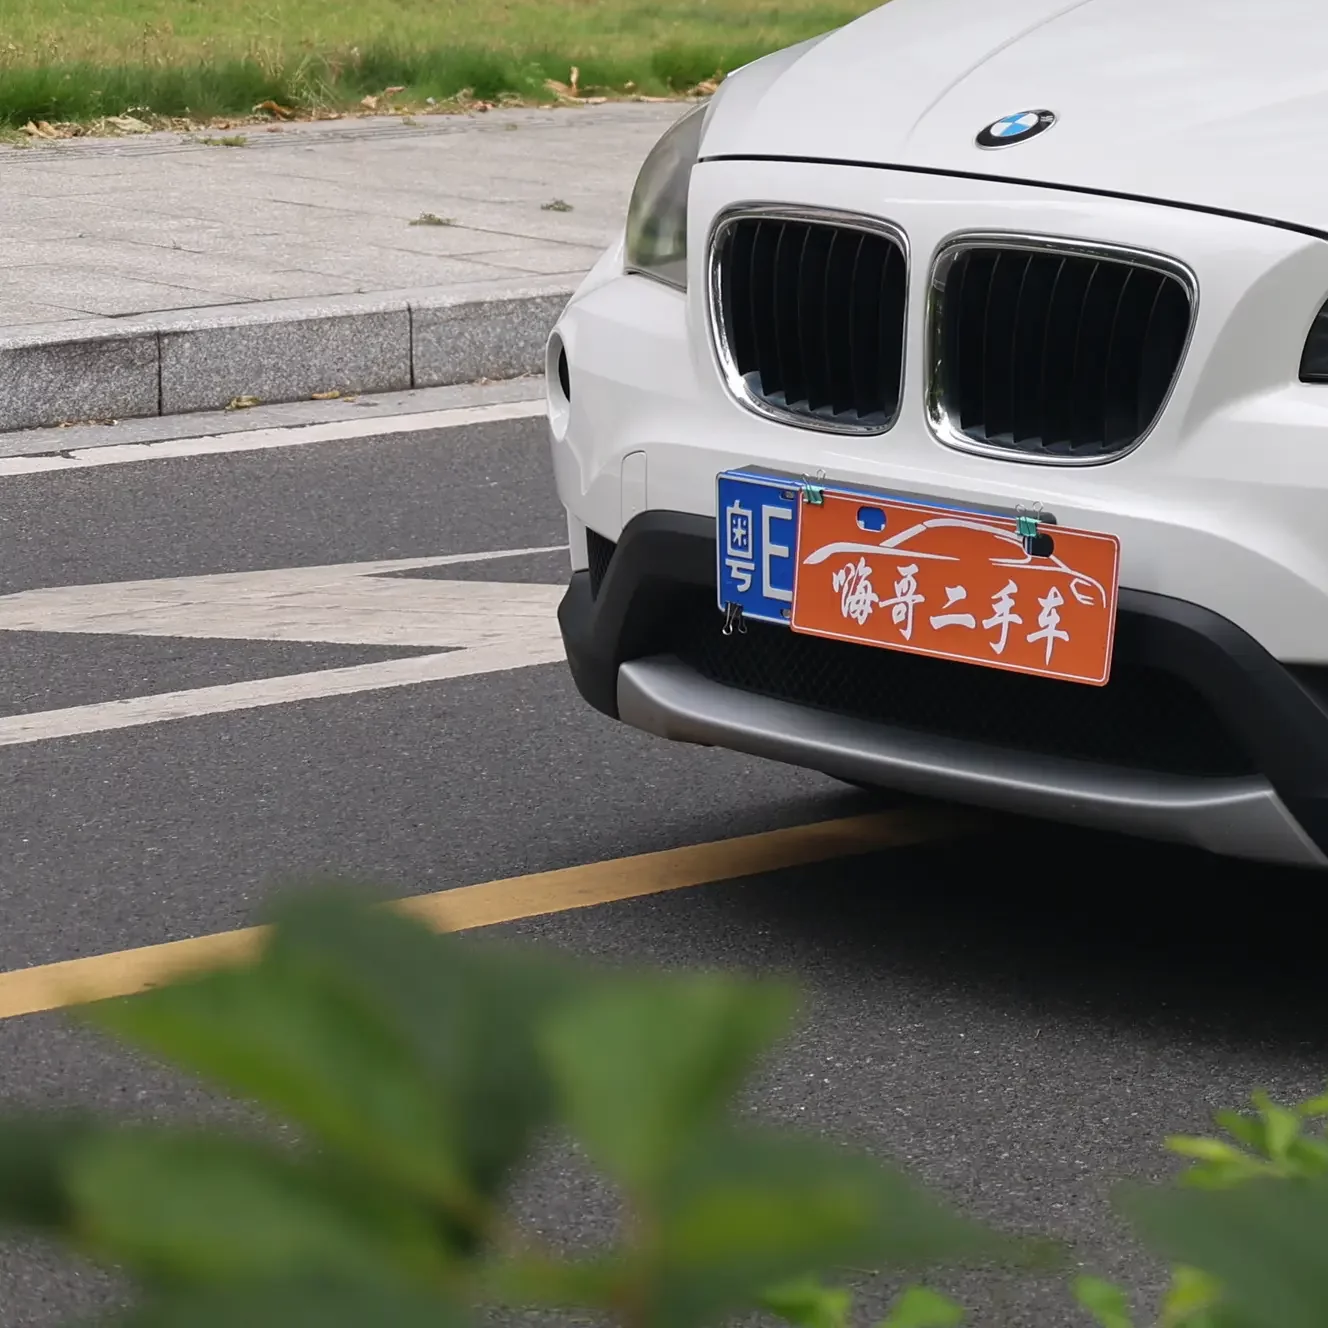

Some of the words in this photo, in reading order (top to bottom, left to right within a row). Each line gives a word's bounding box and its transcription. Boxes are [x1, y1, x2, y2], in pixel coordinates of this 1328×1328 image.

[832, 557, 1069, 665] 嗨哥二手车
